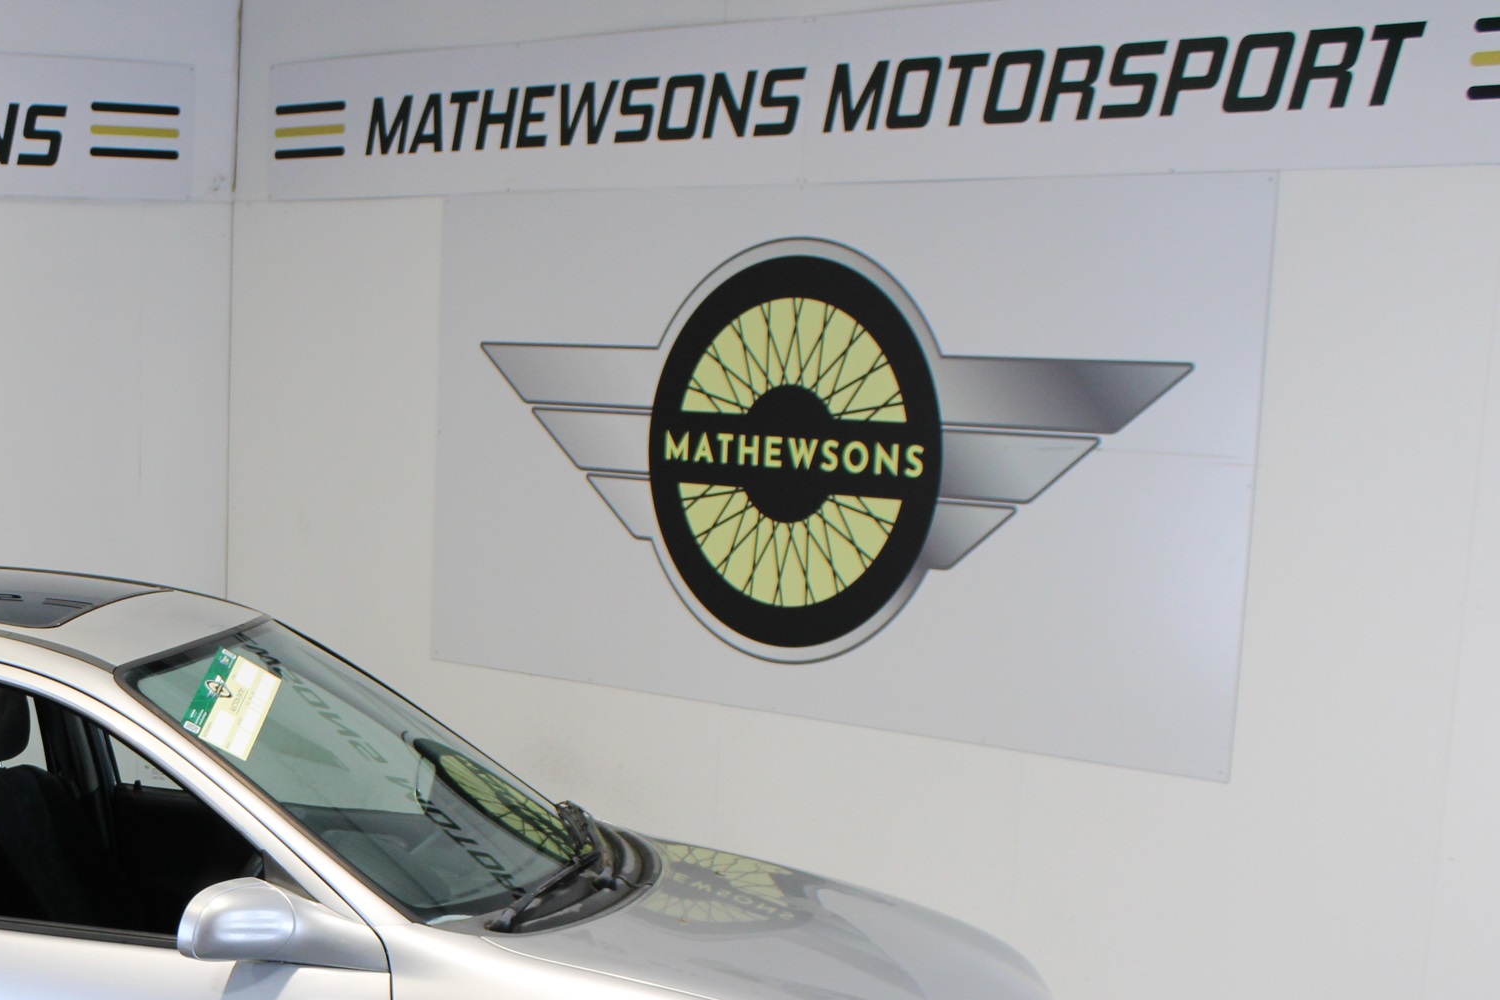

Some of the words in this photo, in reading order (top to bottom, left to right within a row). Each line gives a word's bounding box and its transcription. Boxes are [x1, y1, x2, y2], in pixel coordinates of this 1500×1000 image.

[365, 66, 807, 156] MATHEWSONS
[822, 20, 1428, 134] MOTORSPORT
[664, 430, 925, 478] MATHEWSONS
